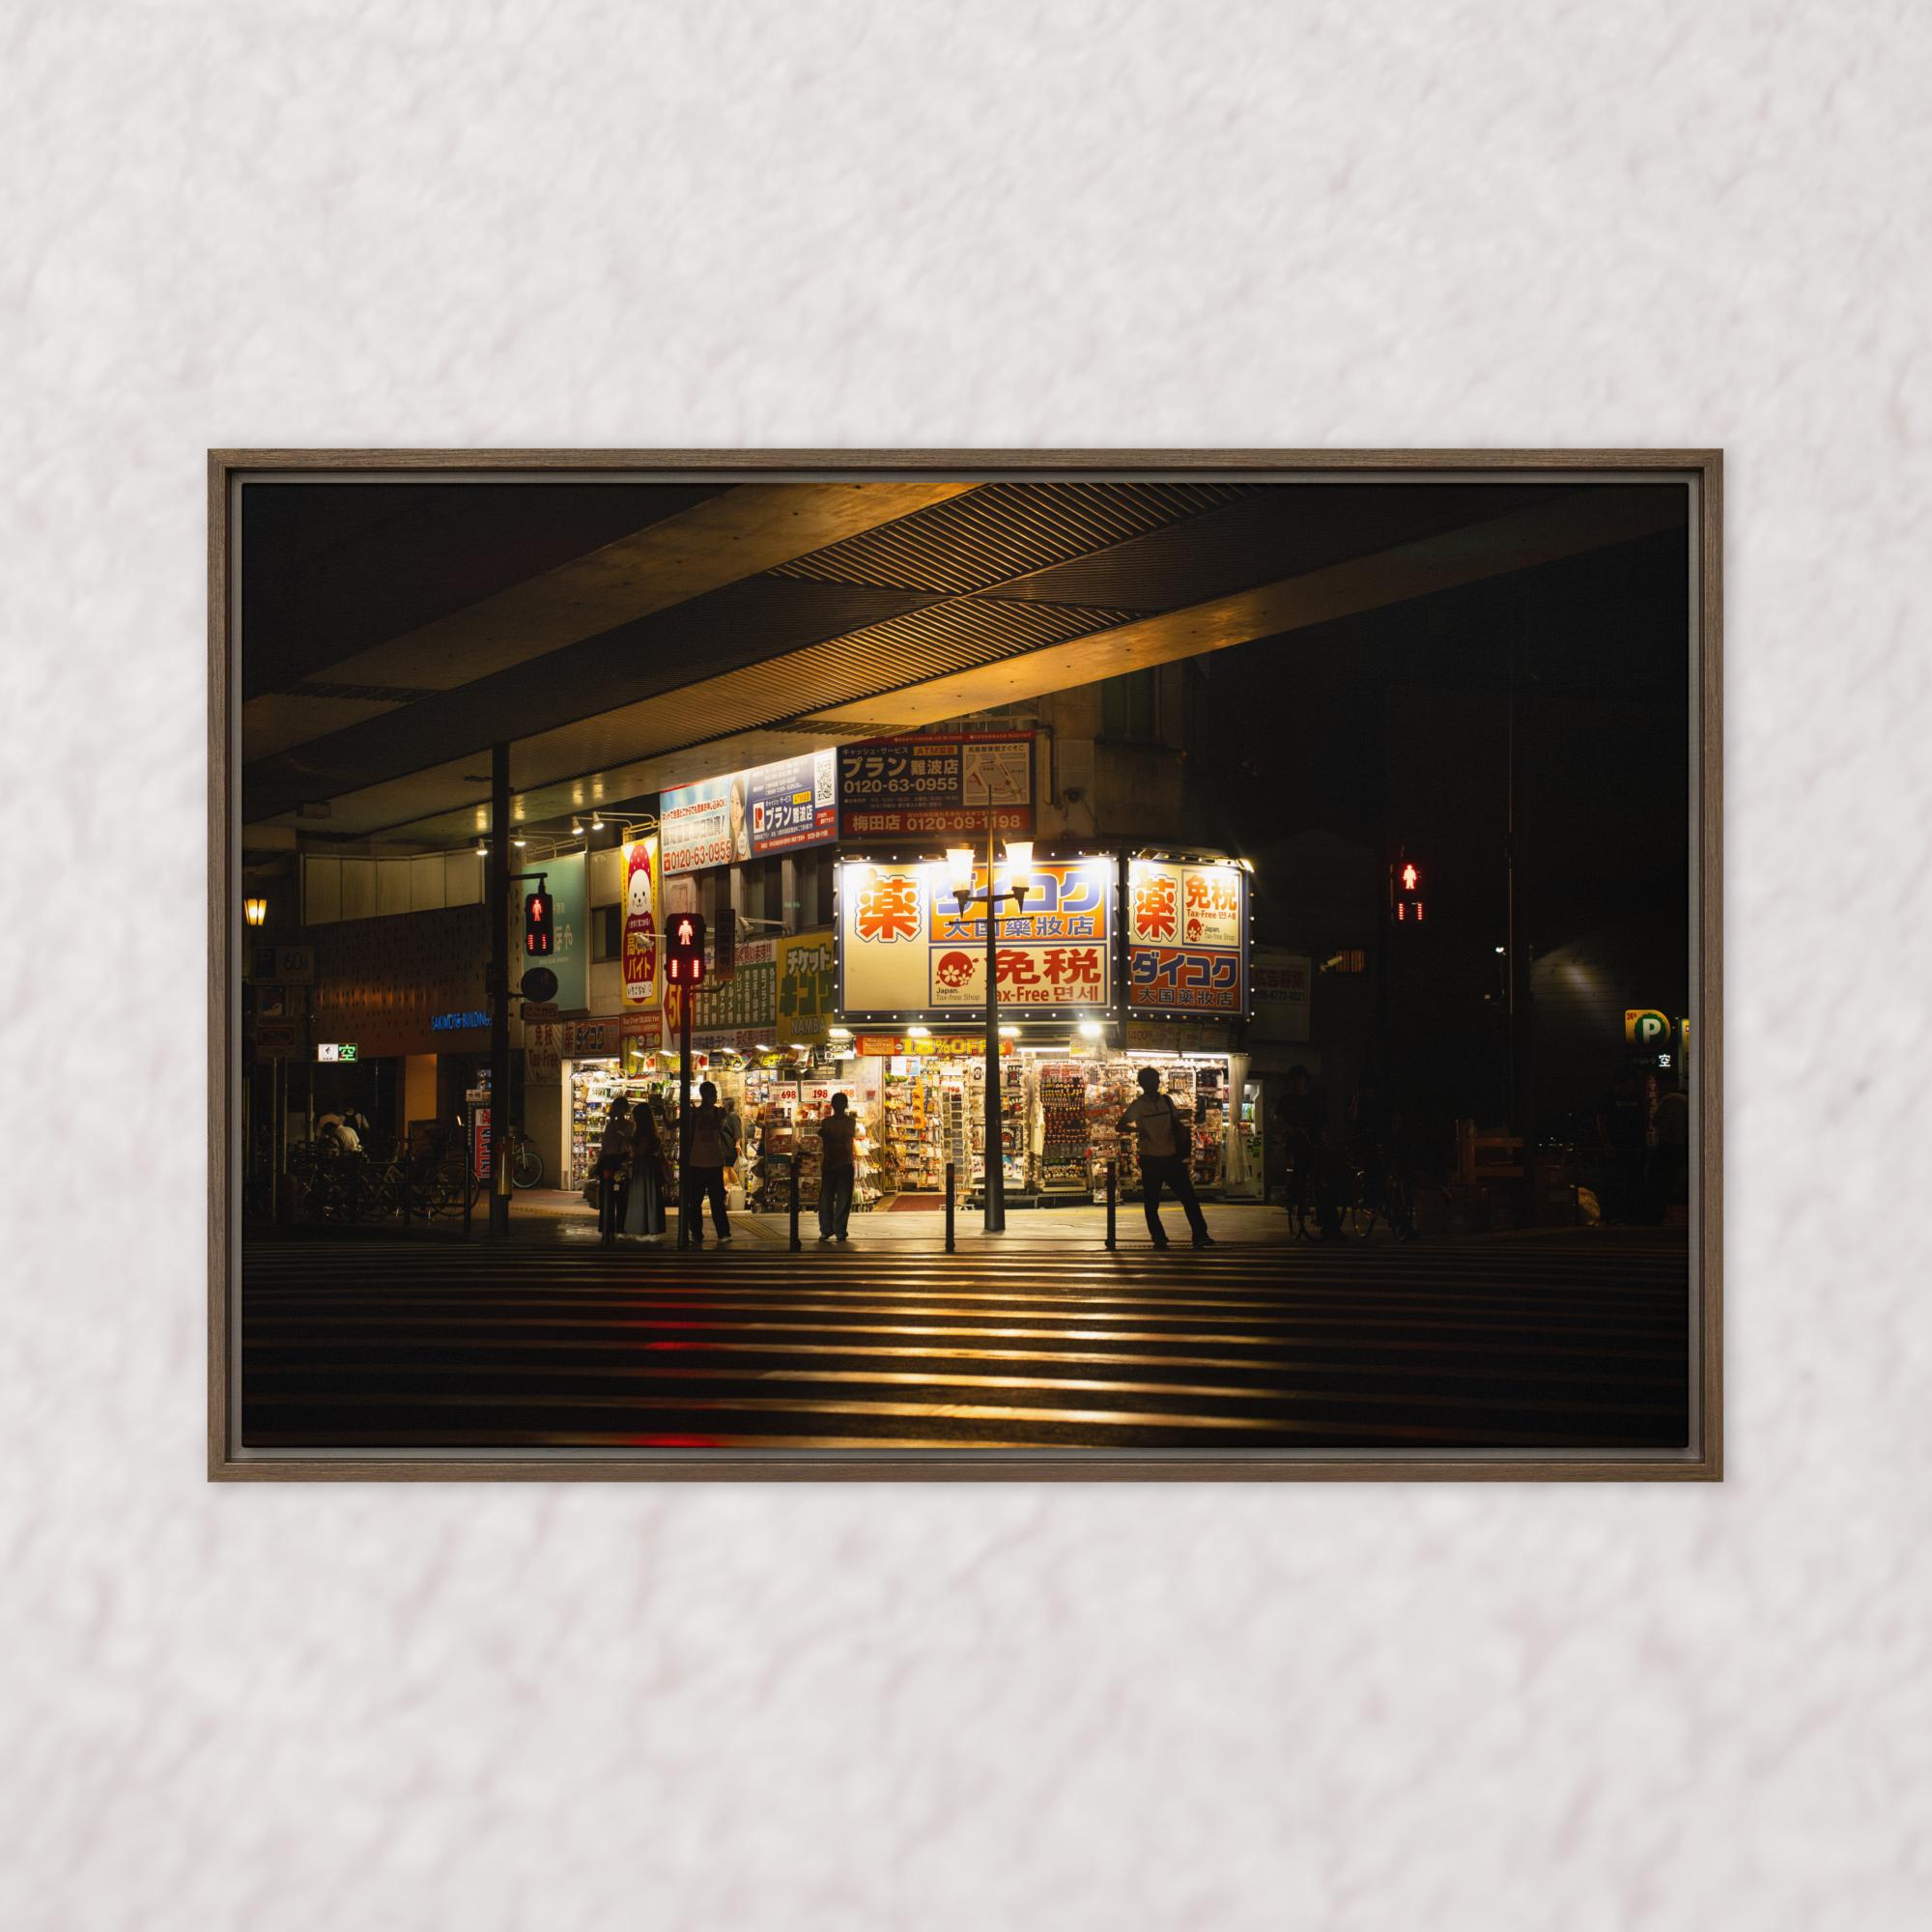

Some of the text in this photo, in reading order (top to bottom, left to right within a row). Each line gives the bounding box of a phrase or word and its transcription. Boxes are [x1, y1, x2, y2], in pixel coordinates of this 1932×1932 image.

[842, 756, 958, 778] プラン 難波店
[843, 778, 958, 794] 0120-63-0955
[765, 806, 792, 831] プラン
[852, 813, 900, 832] 梅田店
[907, 814, 1021, 831] 0120-09-1198
[1186, 876, 1237, 911] 免税
[858, 874, 921, 941] 薬
[1136, 877, 1177, 940] 薬
[1187, 909, 1216, 920] Tax-Free
[628, 956, 652, 980] バイト
[787, 946, 830, 975] チケット
[989, 948, 1101, 984] 免税
[1132, 952, 1237, 988] ダイコク
[996, 985, 1098, 1003] ax-Free 면세
[790, 1017, 828, 1036] NAMBA
[1642, 1018, 1662, 1044] P
[338, 1044, 356, 1063] 空
[1658, 1053, 1671, 1067] 空
[781, 1091, 796, 1099] 698
[812, 1090, 828, 1099] 198
